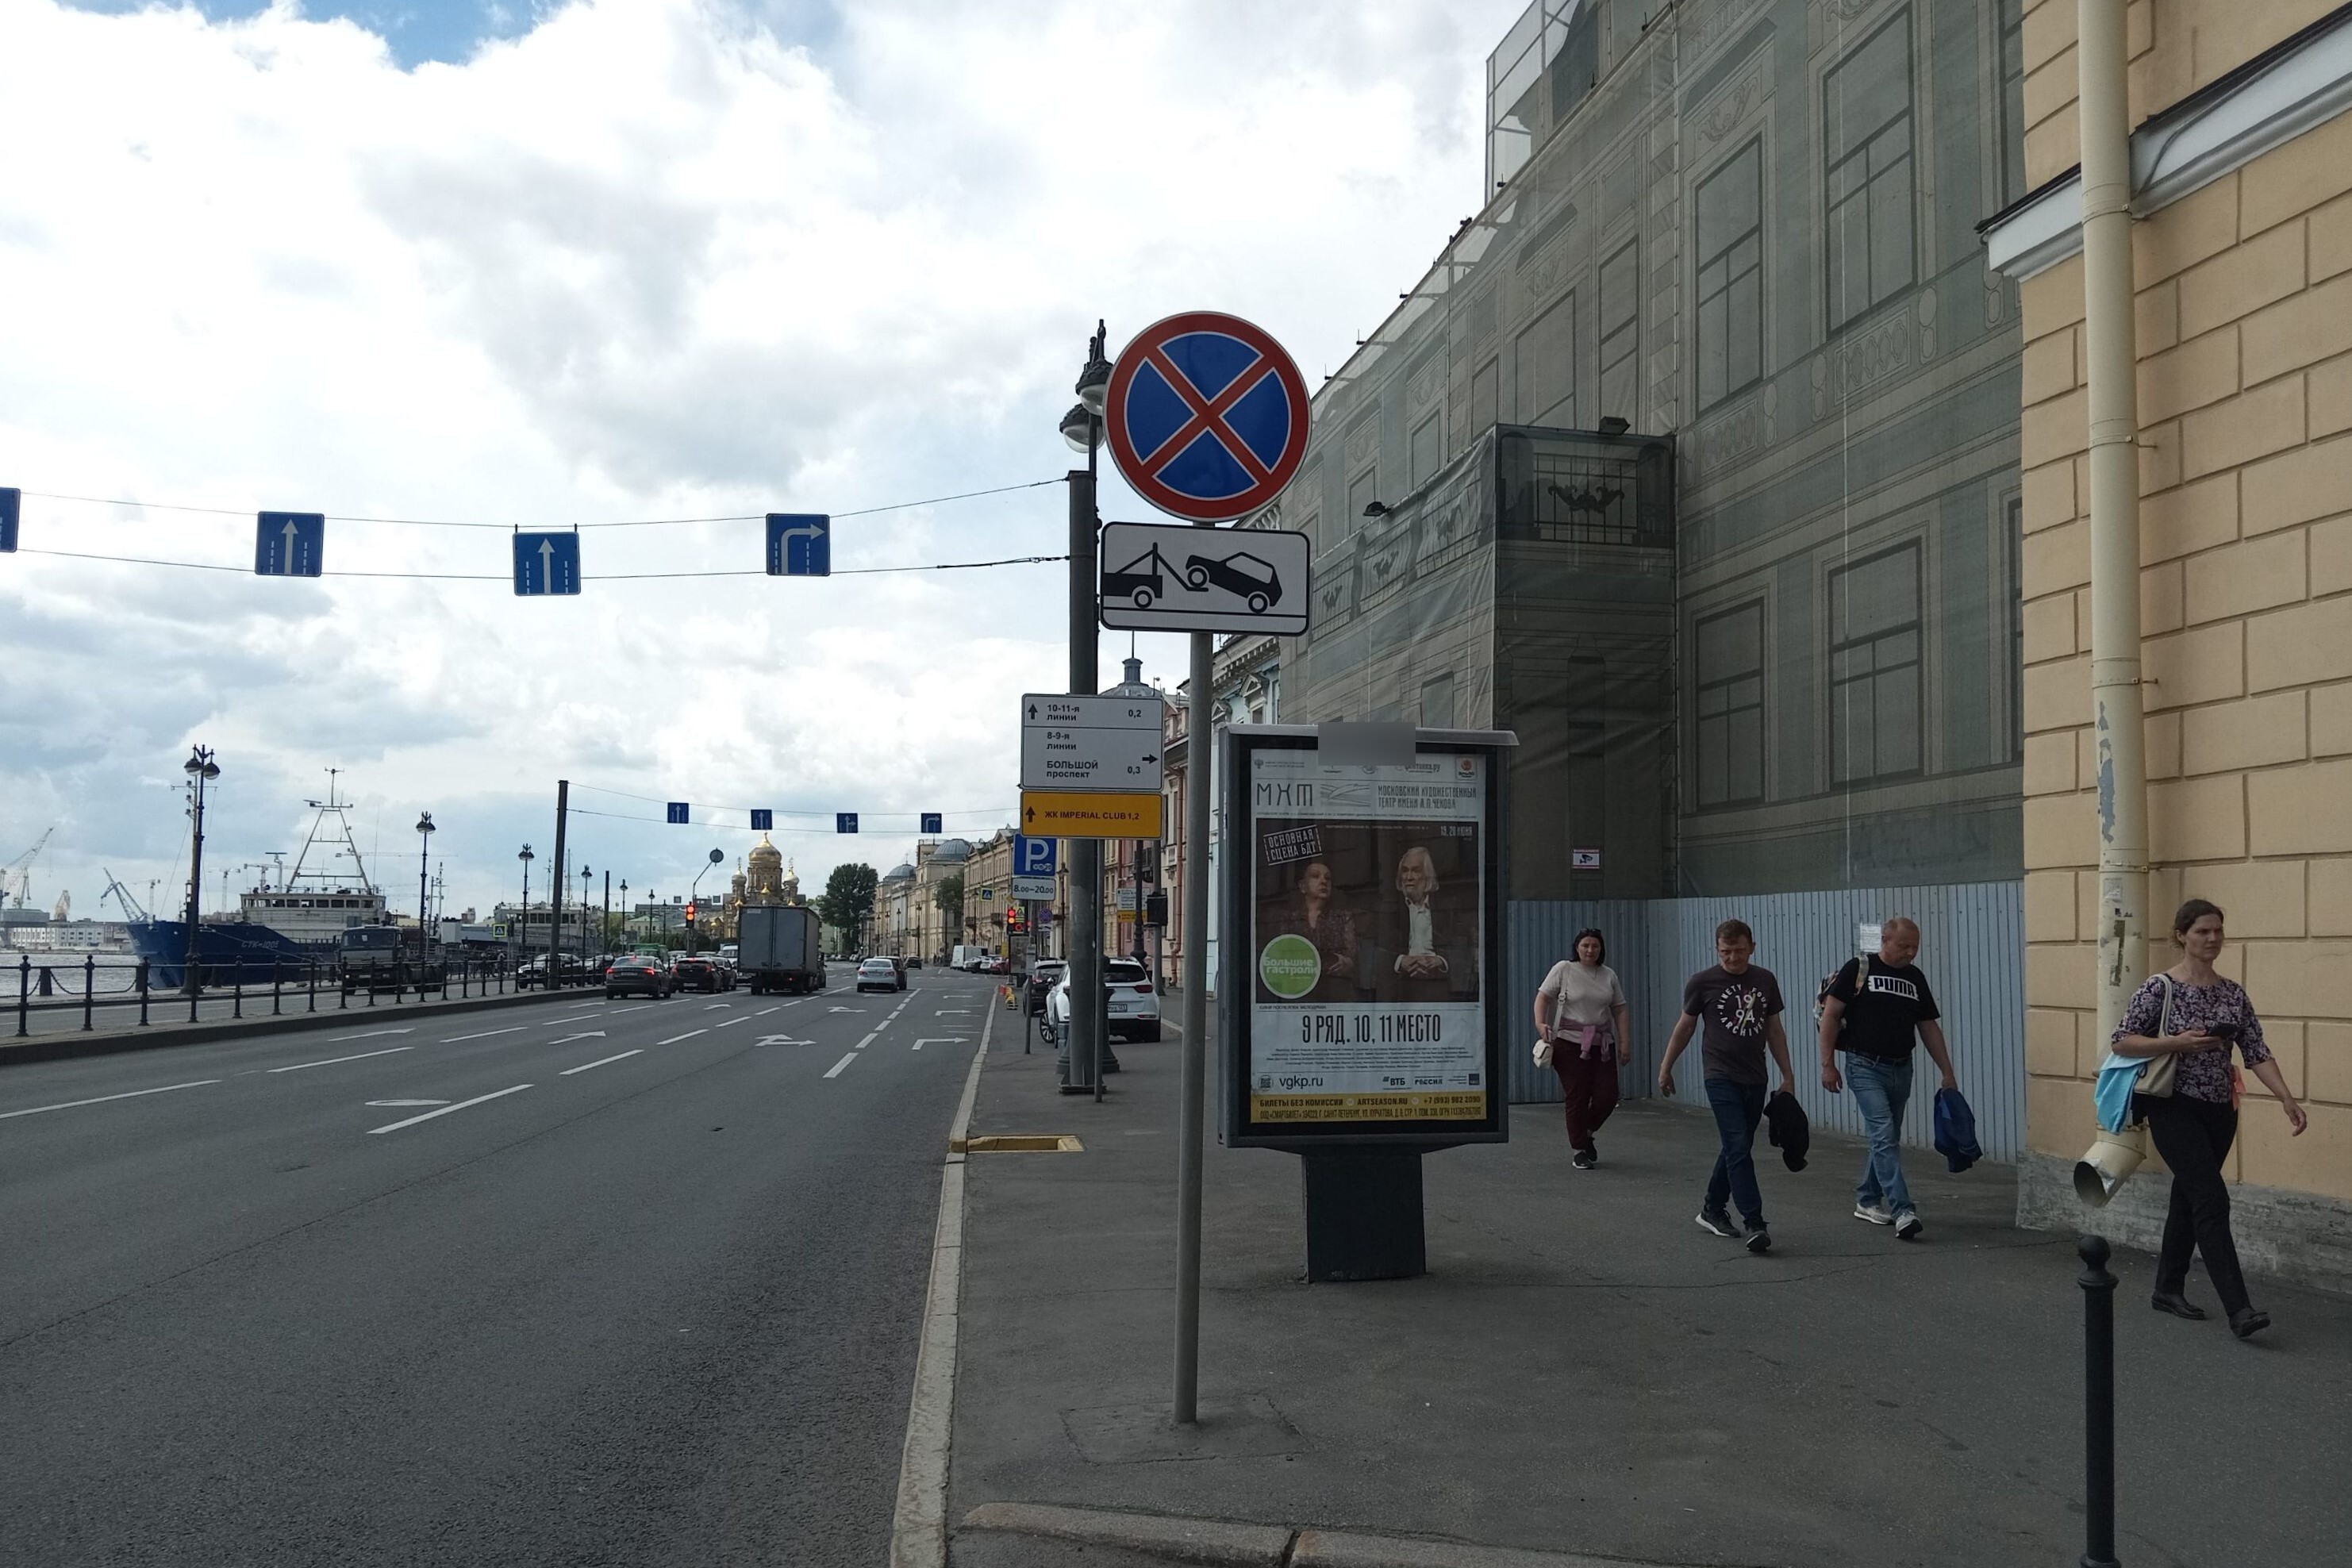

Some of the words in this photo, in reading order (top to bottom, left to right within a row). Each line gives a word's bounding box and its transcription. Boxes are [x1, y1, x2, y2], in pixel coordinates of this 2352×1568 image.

[1047, 759, 1098, 769] БОЛЬШОЙ
[1127, 766, 1141, 774] 0,3
[1378, 785, 1420, 797] МОСКОВСКИЙ
[1421, 786, 1477, 798] ХУДОЖЕСТВЕННЫЙ
[1378, 797, 1397, 808] ТЕАТР
[1397, 798, 1418, 809] ИМЕНИ
[1268, 828, 1314, 848] ОСНОВНАЯ
[1270, 844, 1299, 861] СЦЕНА
[1301, 841, 1316, 855] БДТ
[1716, 984, 1742, 1009] NINETY
[1874, 977, 1916, 998] PUMA
[1751, 987, 1767, 1009] FOUR
[1302, 1015, 1311, 1043] 9
[1316, 1015, 1351, 1045] РЯД.
[1355, 1014, 1375, 1044] 10,
[1379, 1015, 1392, 1043] 11
[1397, 1014, 1441, 1043] МЕСТО
[1720, 1017, 1765, 1036] ARCHIVES
[1279, 1075, 1324, 1090] vgkp.ru
[1358, 1097, 1408, 1106] ARTSEASON.RU
